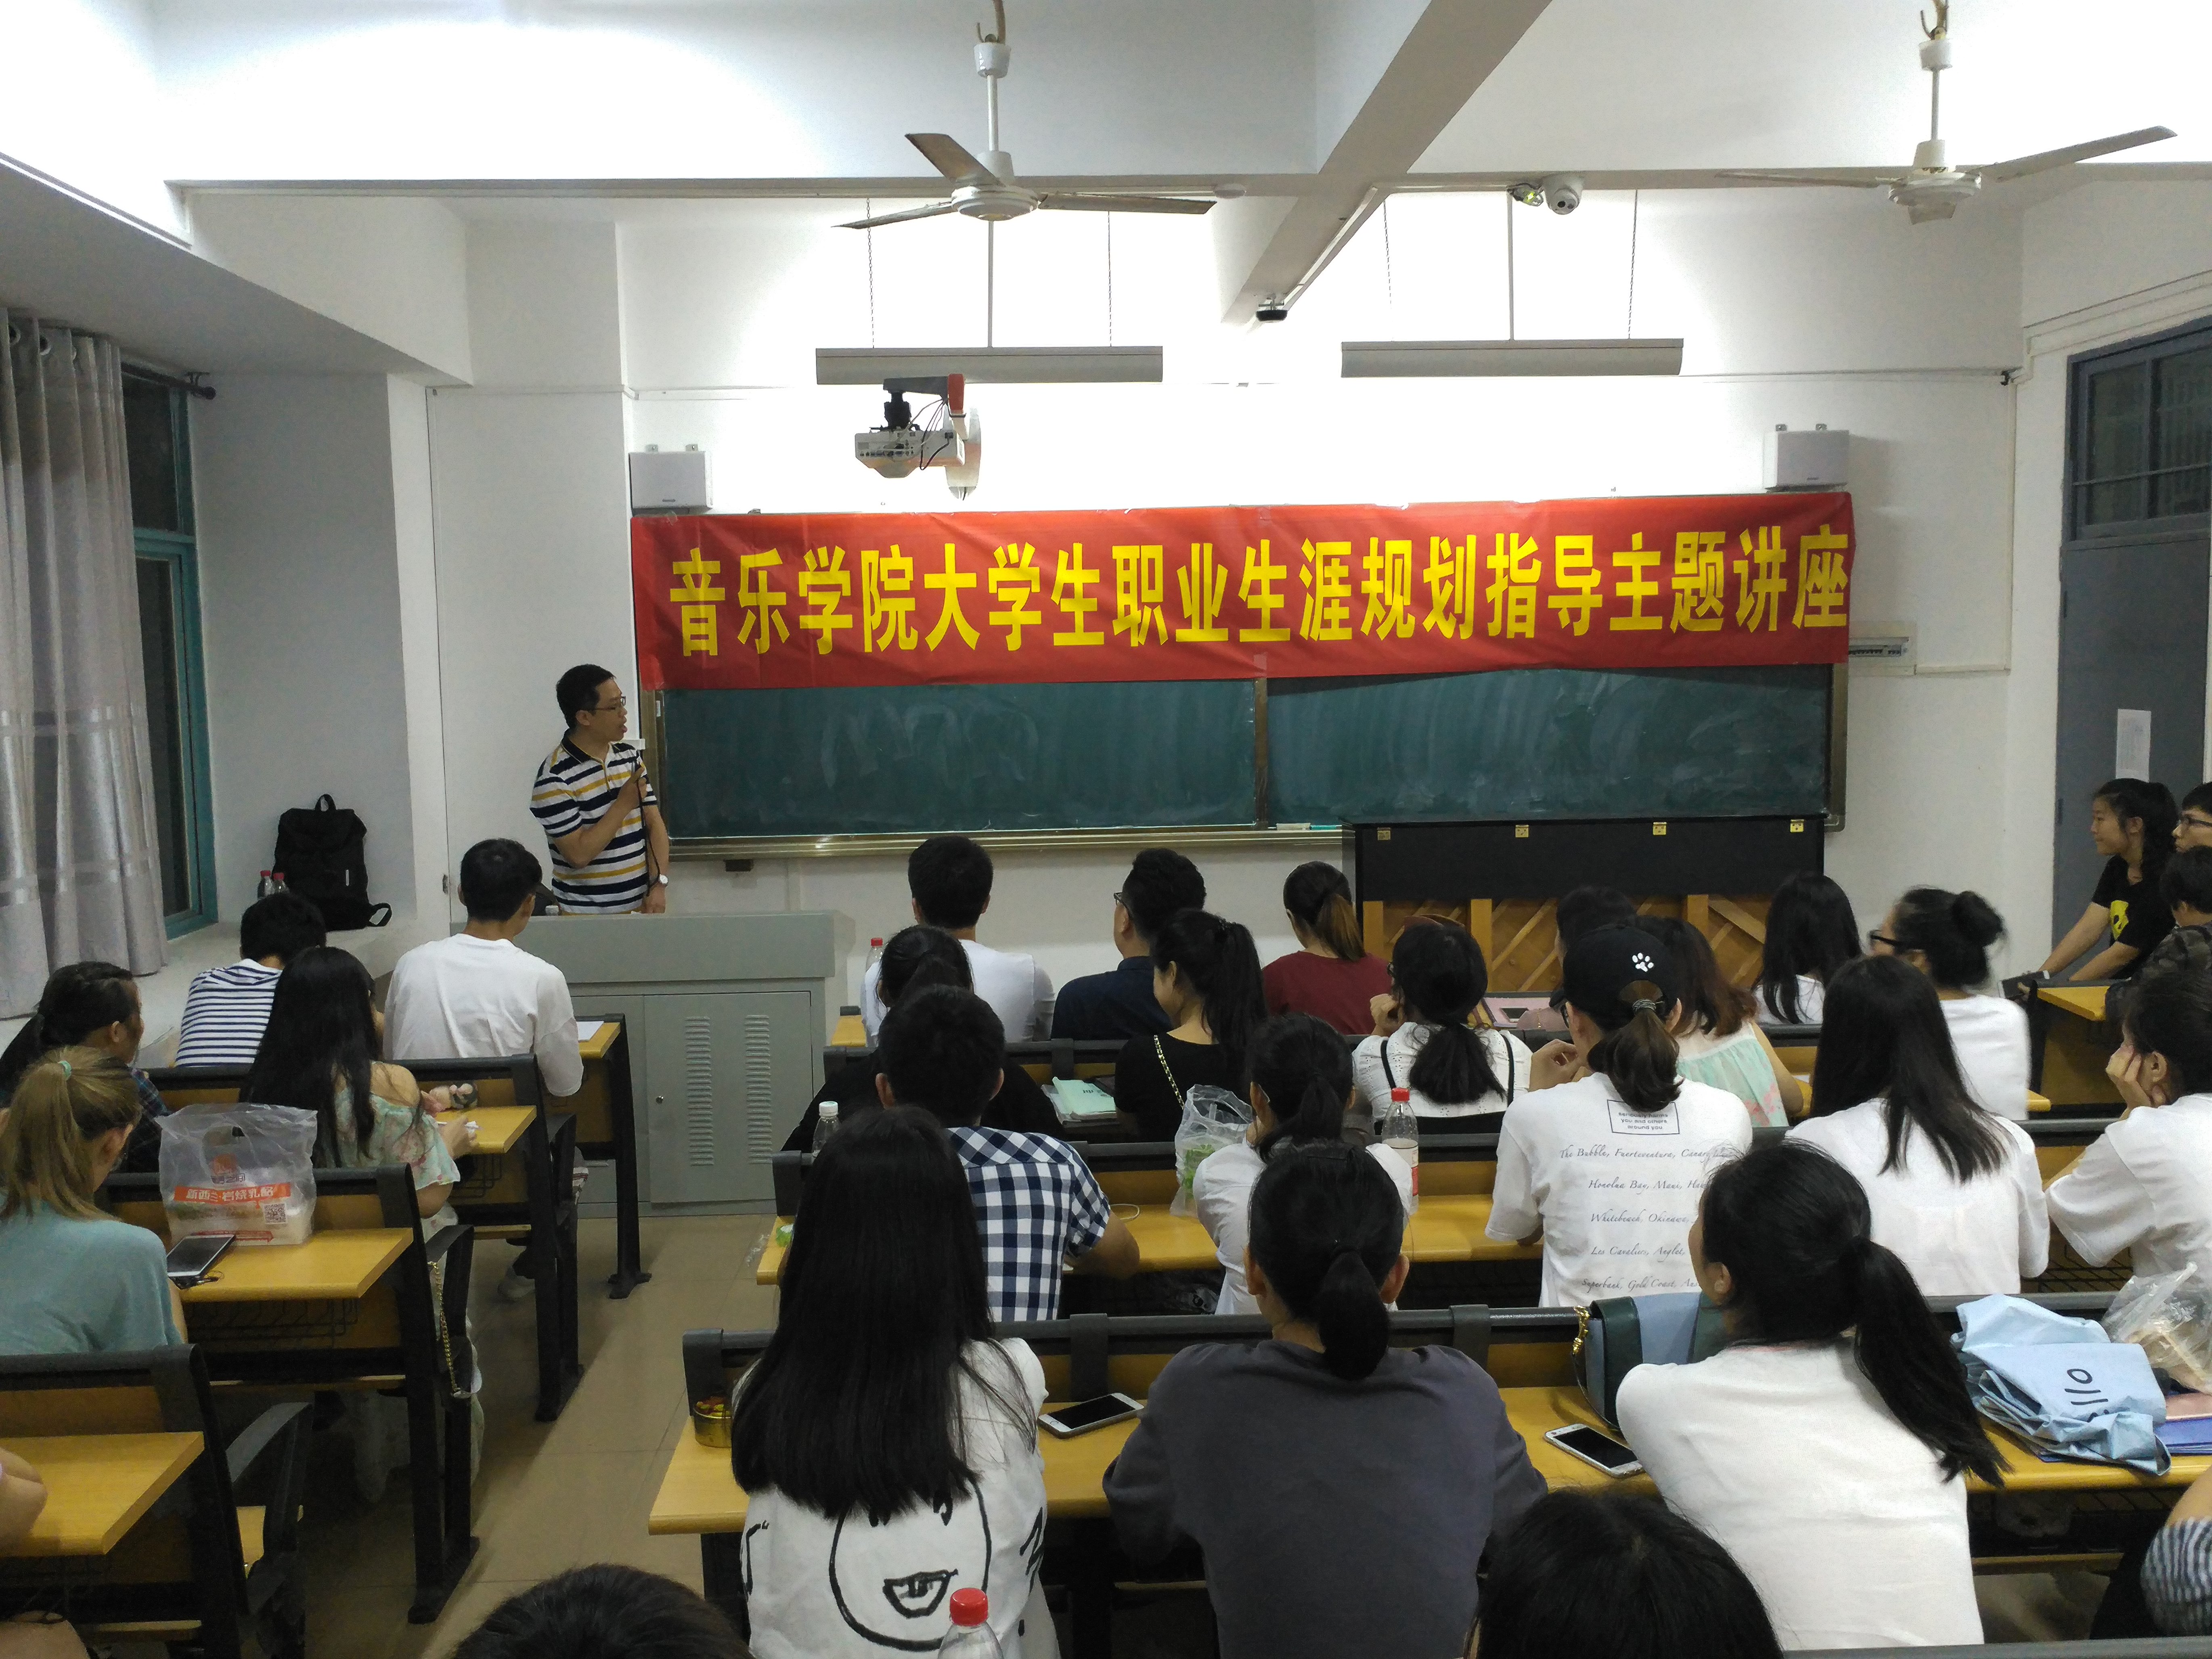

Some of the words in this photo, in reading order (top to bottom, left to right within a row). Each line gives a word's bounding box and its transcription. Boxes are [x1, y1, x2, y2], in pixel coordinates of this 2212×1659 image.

[668, 524, 1849, 657] 音乐学院大学生职业生涯规划指导主题讲座
[1560, 1144, 1574, 1158] The
[1577, 1144, 1610, 1158] Bubble,
[1591, 1246, 1605, 1255] Les
